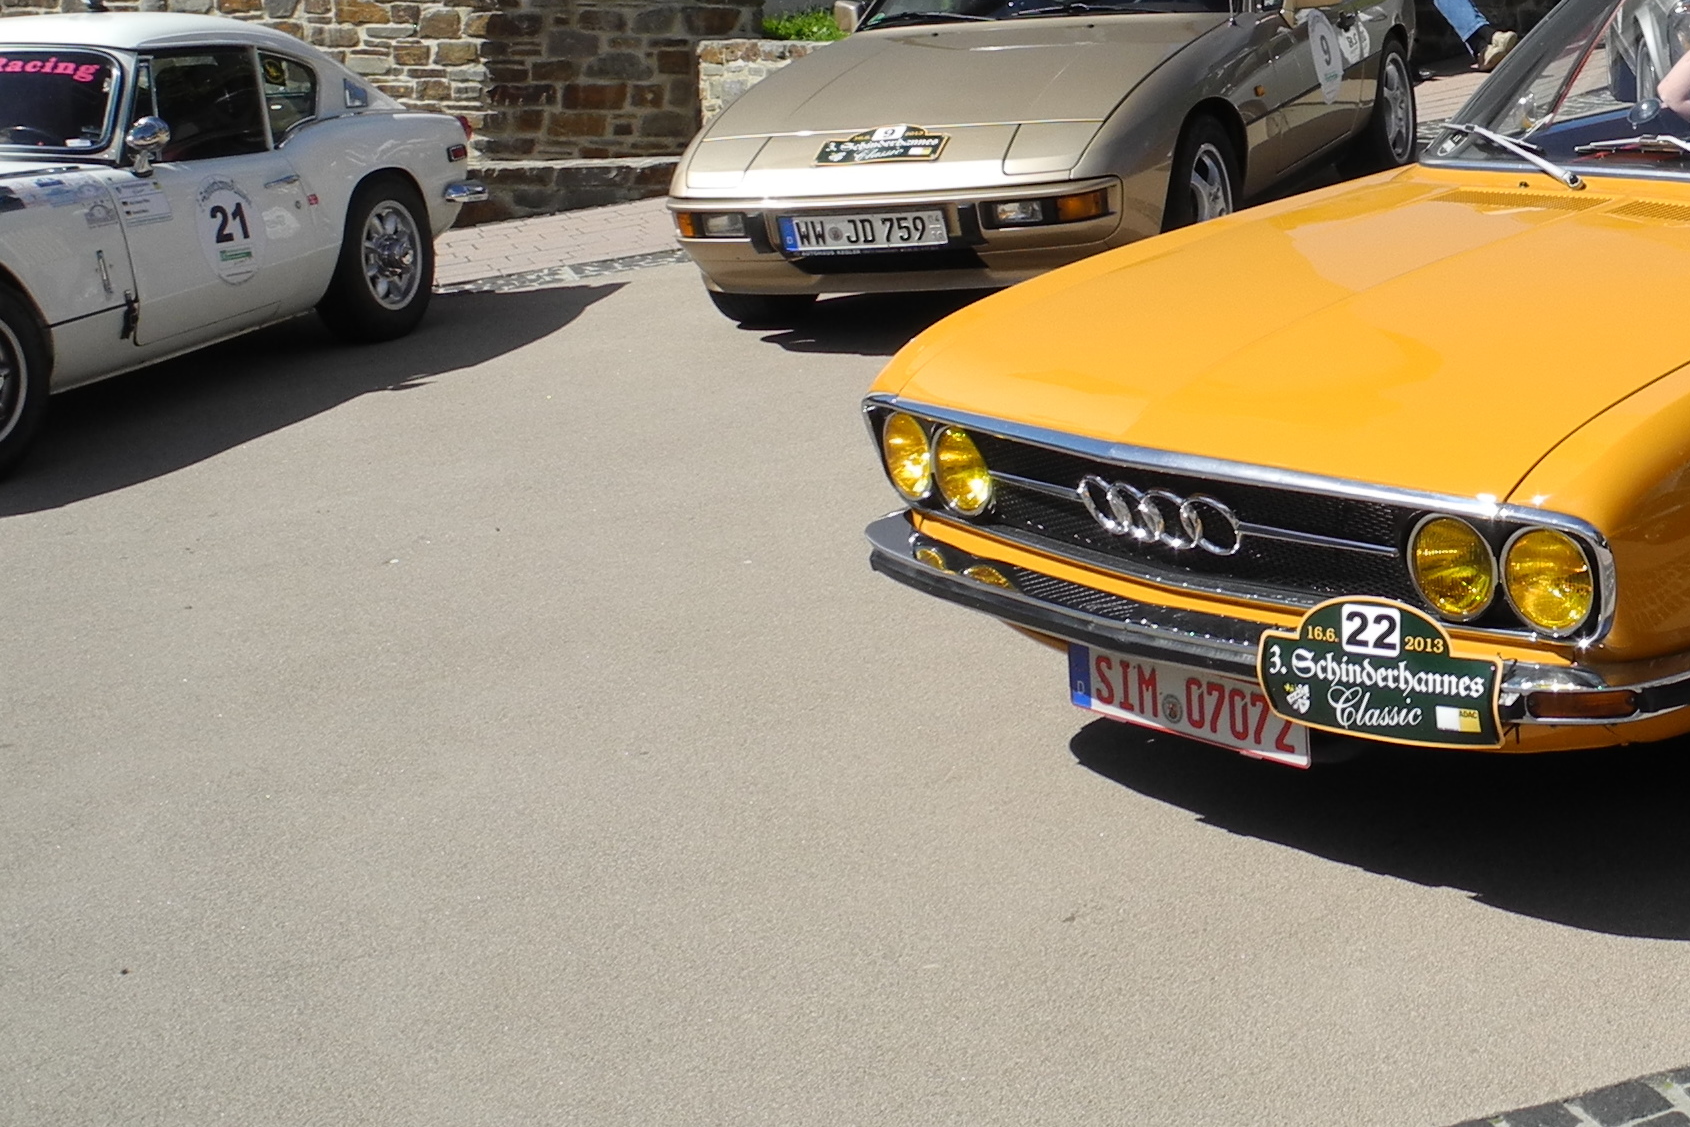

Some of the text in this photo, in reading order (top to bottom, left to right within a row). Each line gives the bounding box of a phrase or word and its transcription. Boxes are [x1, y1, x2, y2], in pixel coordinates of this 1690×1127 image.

[1320, 34, 1332, 67] 9
[883, 127, 895, 138] 9
[209, 202, 250, 244] 21
[795, 216, 926, 246] WW JD 759
[1306, 611, 1444, 654] 16.6. 22 2013
[1095, 655, 1159, 719] SIM
[1268, 644, 1486, 699] 3. Schinderhannes
[1327, 685, 1423, 730] Classic
[1459, 710, 1478, 720] ADAC
